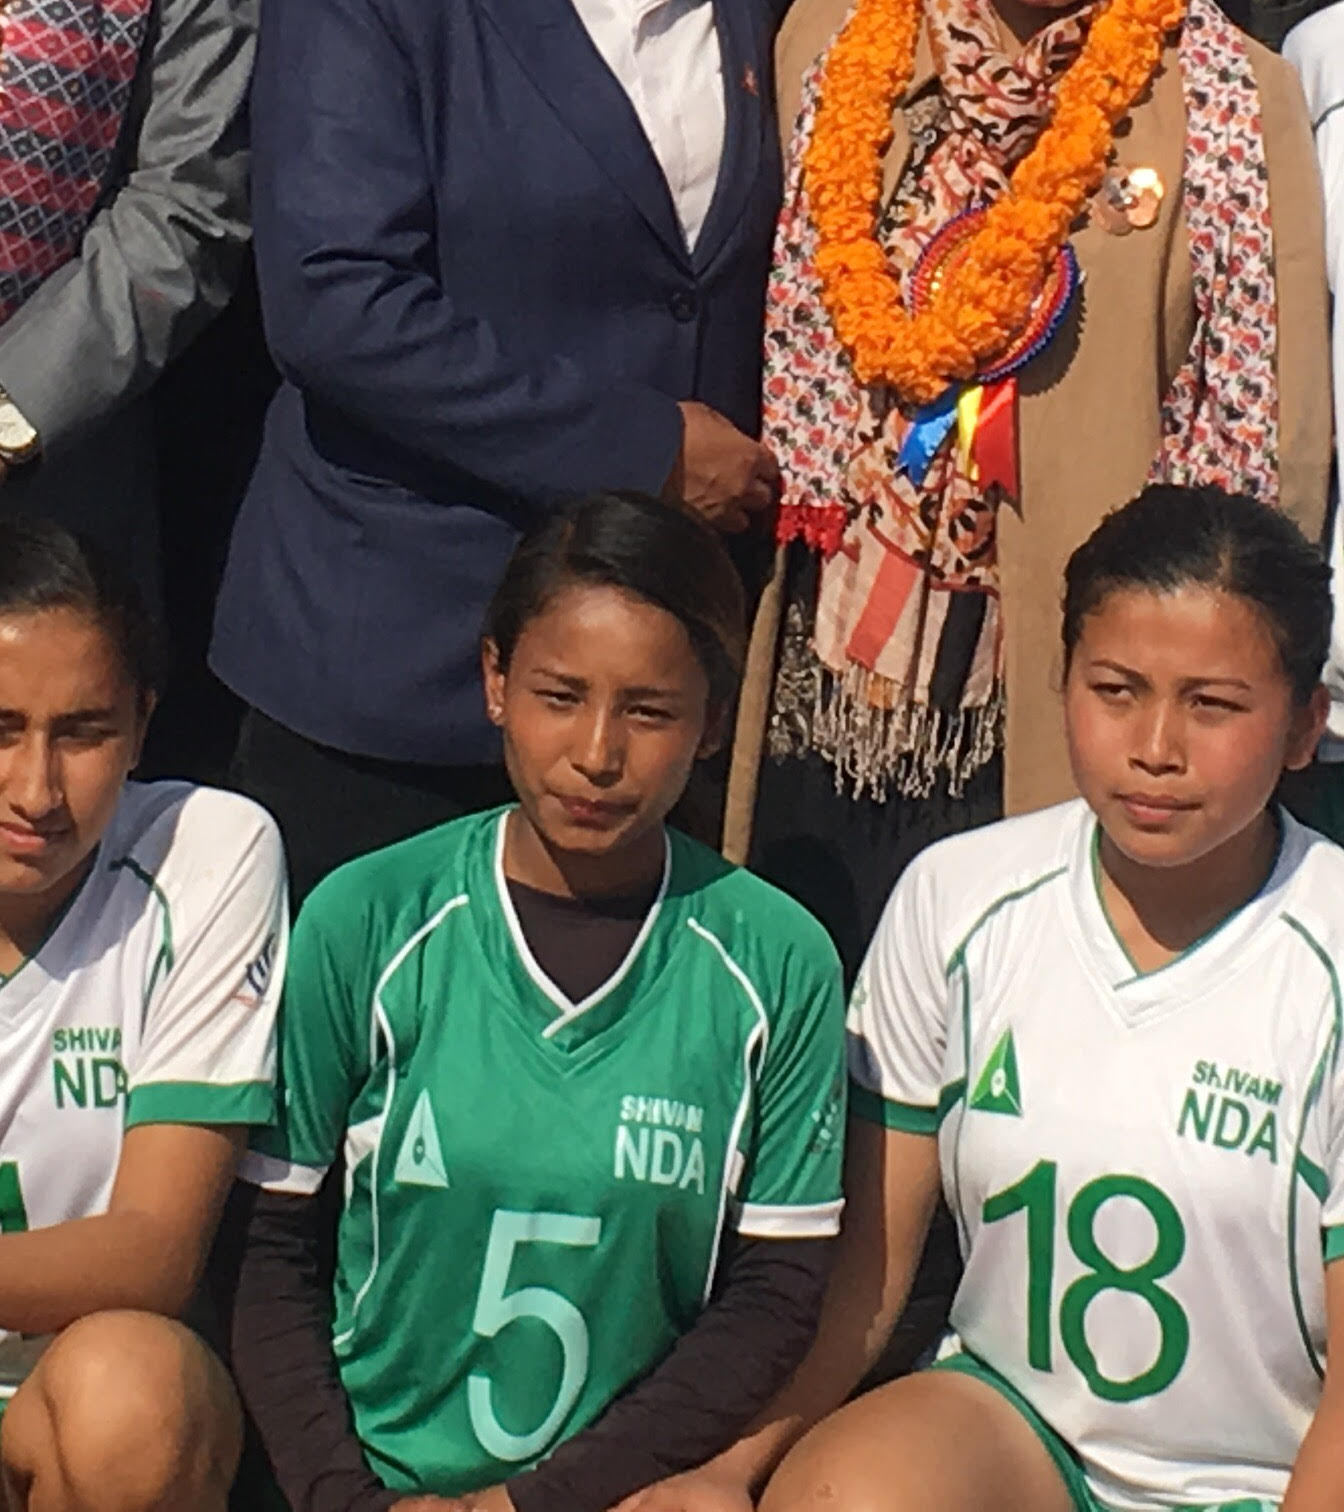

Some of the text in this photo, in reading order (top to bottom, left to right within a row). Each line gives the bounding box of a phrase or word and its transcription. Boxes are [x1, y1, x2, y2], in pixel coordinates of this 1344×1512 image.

[53, 1026, 123, 1052] SHIVA
[620, 1095, 704, 1132] SHIVAM
[1192, 1060, 1283, 1106] SHIVAM
[614, 1124, 705, 1195] NDA
[1176, 1087, 1278, 1166] NDA
[982, 1160, 1191, 1405] 18
[467, 1208, 602, 1462] 5
